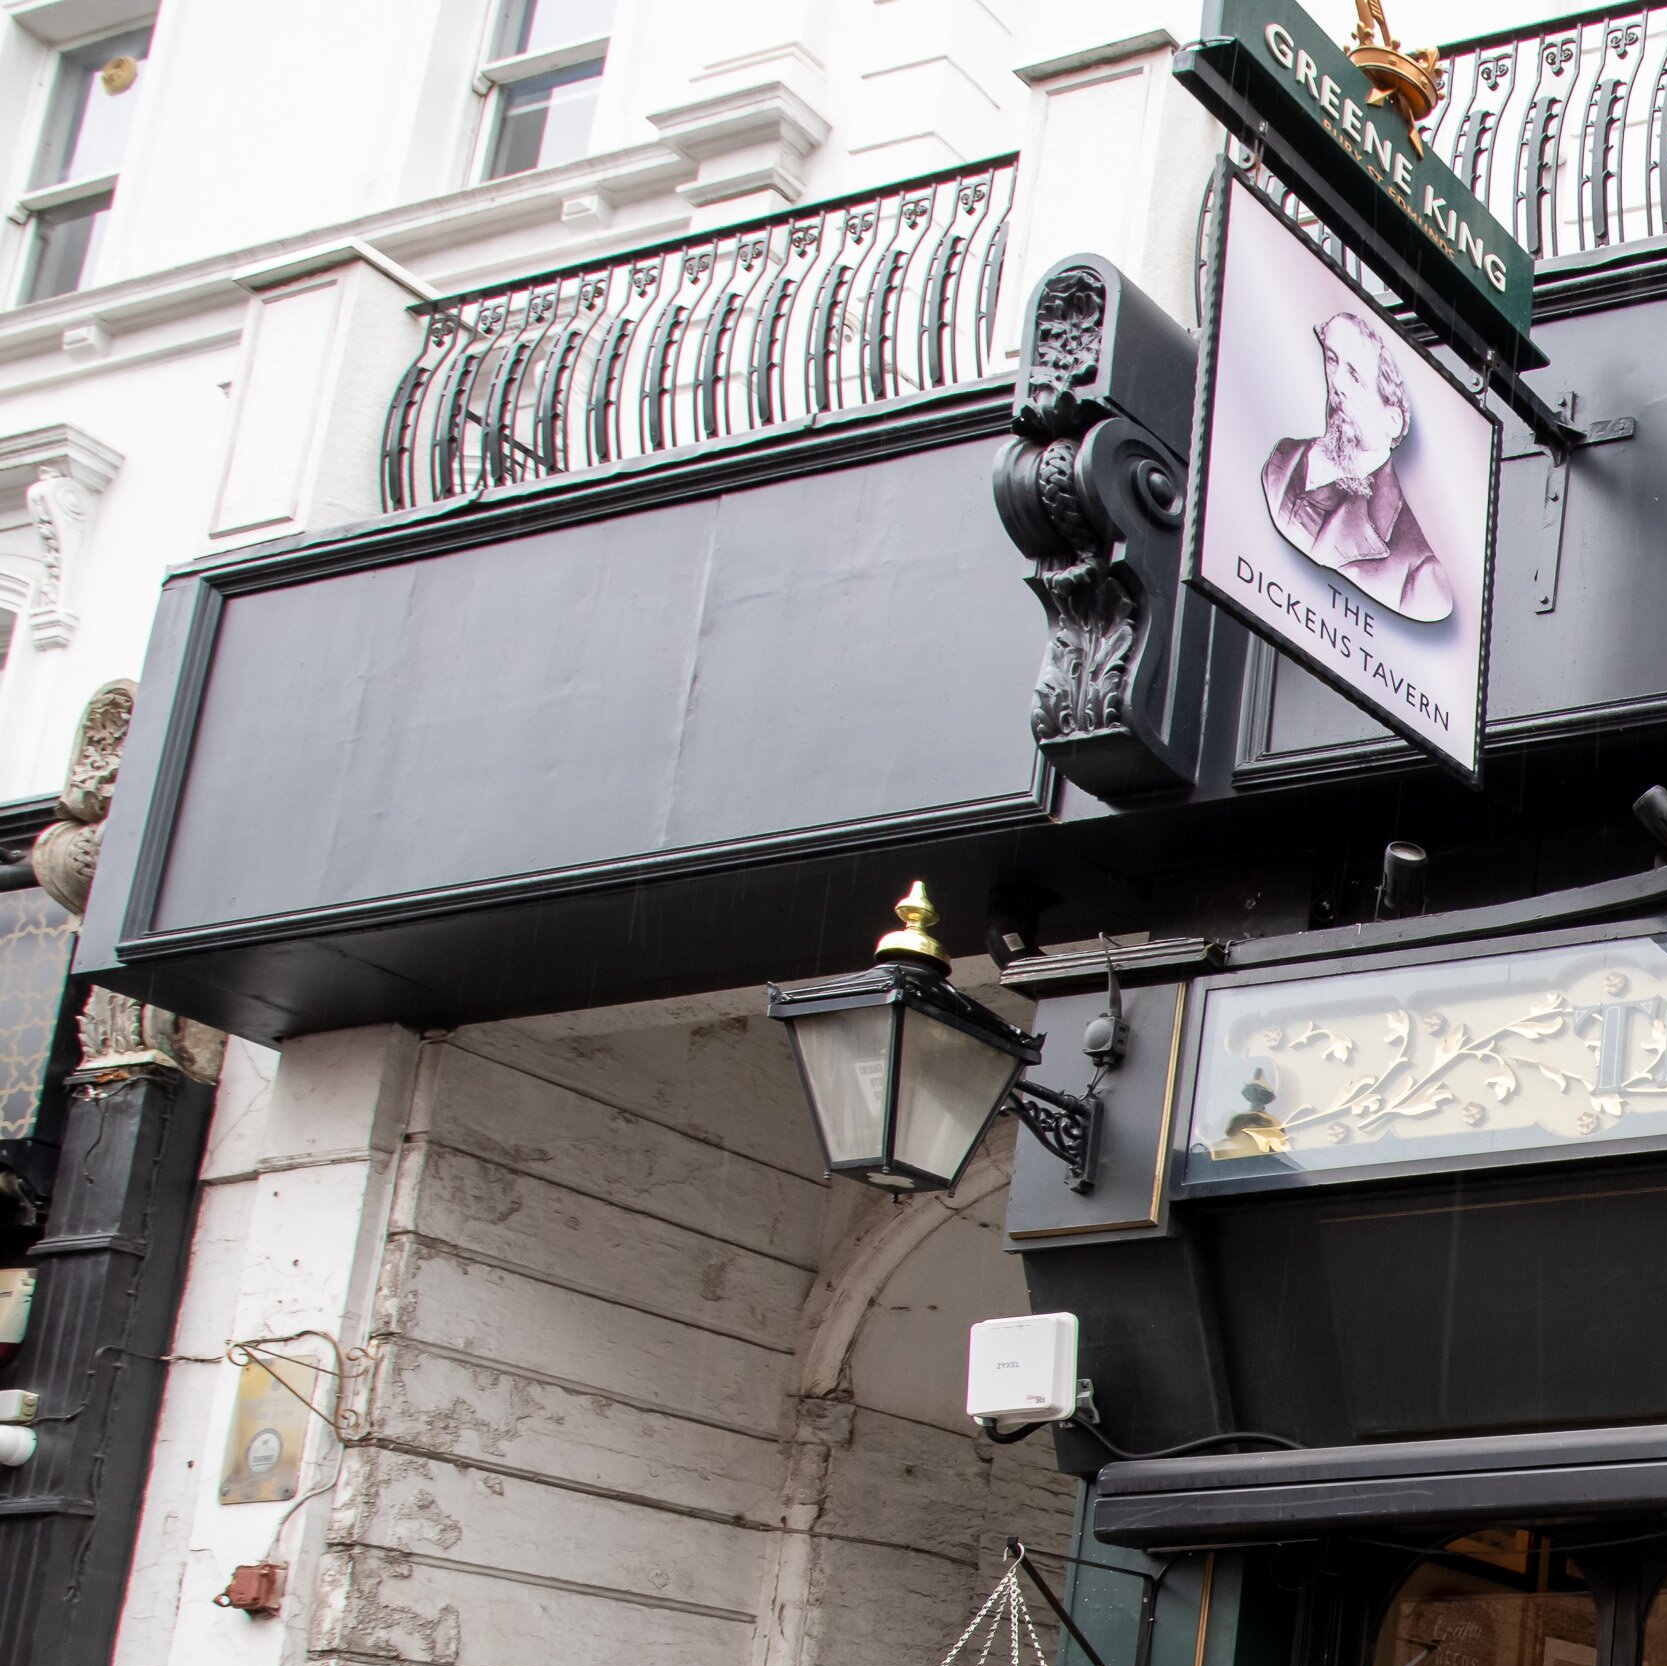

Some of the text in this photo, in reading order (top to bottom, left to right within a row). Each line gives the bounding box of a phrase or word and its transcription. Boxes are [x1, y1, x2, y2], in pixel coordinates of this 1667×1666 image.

[1264, 22, 1507, 293] GREENE KING
[1236, 555, 1450, 732] DICKENS TAVERN
[1327, 583, 1375, 638] THE
